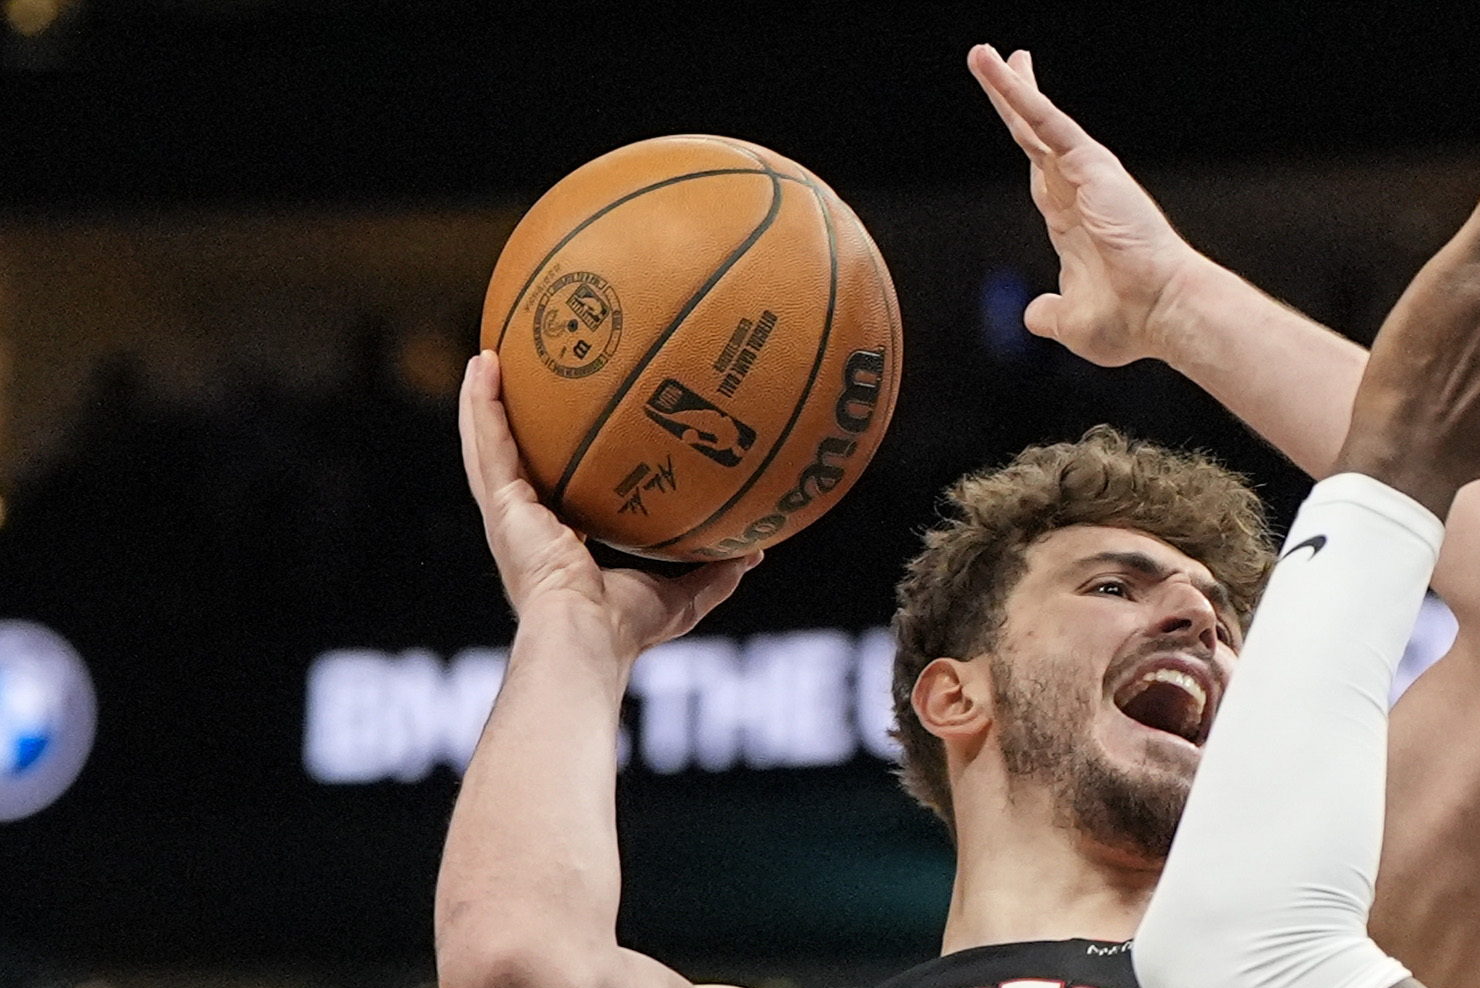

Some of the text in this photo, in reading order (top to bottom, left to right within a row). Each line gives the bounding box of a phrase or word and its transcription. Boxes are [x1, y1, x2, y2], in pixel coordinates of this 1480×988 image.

[745, 309, 779, 352] OFFICIAL
[730, 348, 757, 378] GAME
[717, 374, 742, 399] BALL
